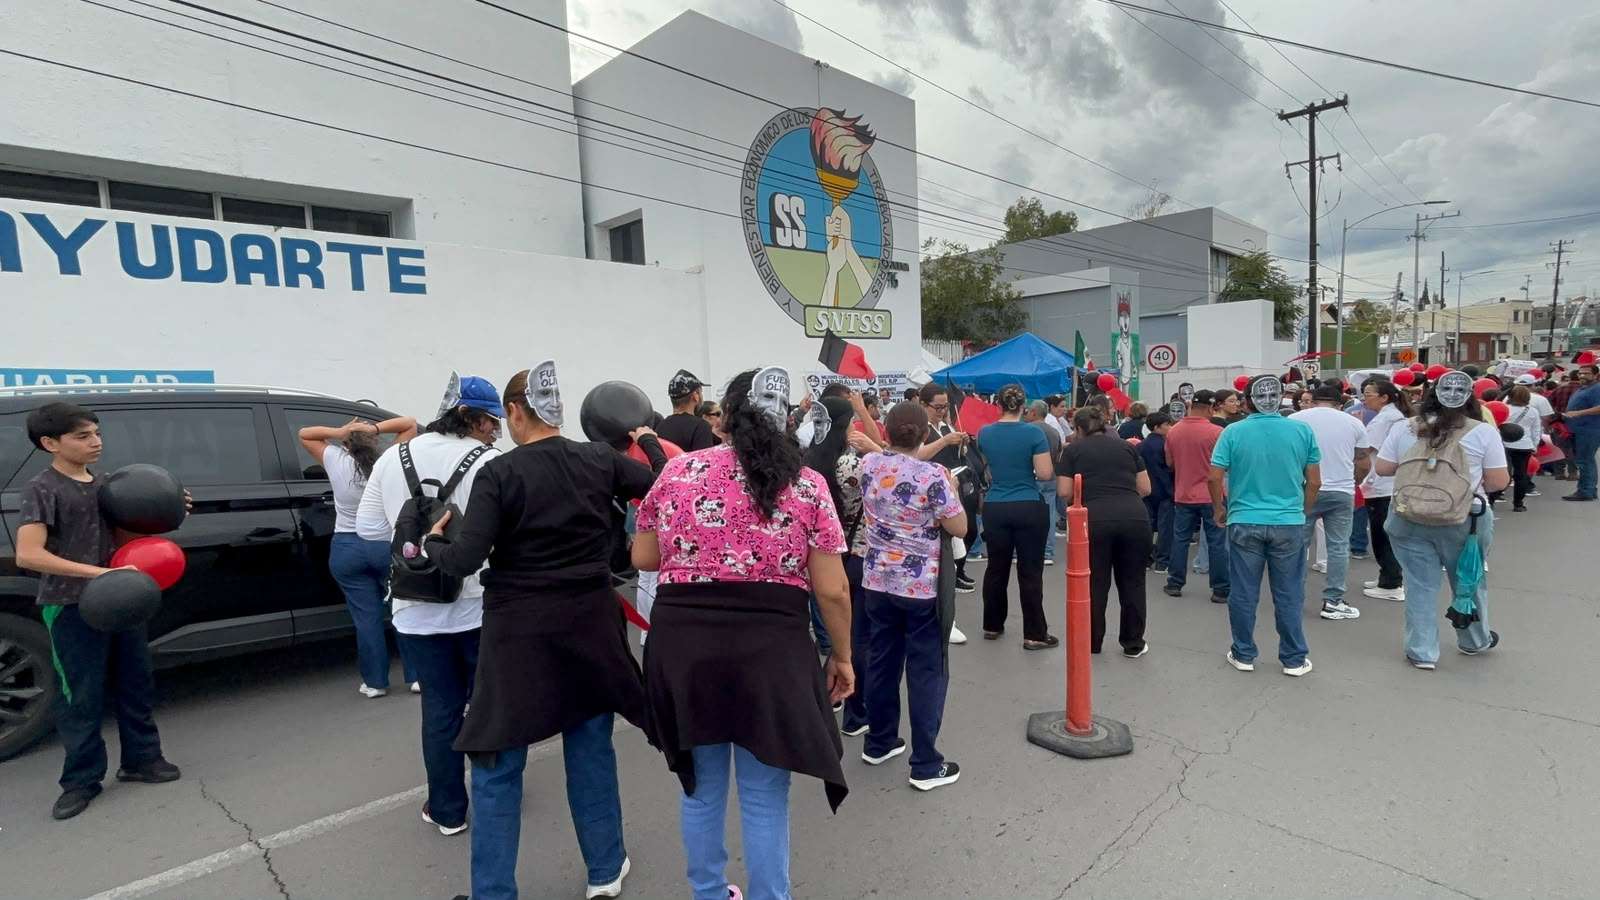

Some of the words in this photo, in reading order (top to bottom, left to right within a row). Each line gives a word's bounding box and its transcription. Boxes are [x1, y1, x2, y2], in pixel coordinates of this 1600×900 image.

[780, 113, 794, 130] DE
[794, 112, 810, 125] LOS
[745, 122, 780, 190] ECONOMICO
[772, 192, 807, 250] SS
[870, 168, 891, 298] TRABAJADORES
[743, 196, 780, 294] BIENESTAR
[783, 298, 792, 312] Y
[814, 310, 885, 333] SNTSS
[1154, 351, 1170, 361] 40
